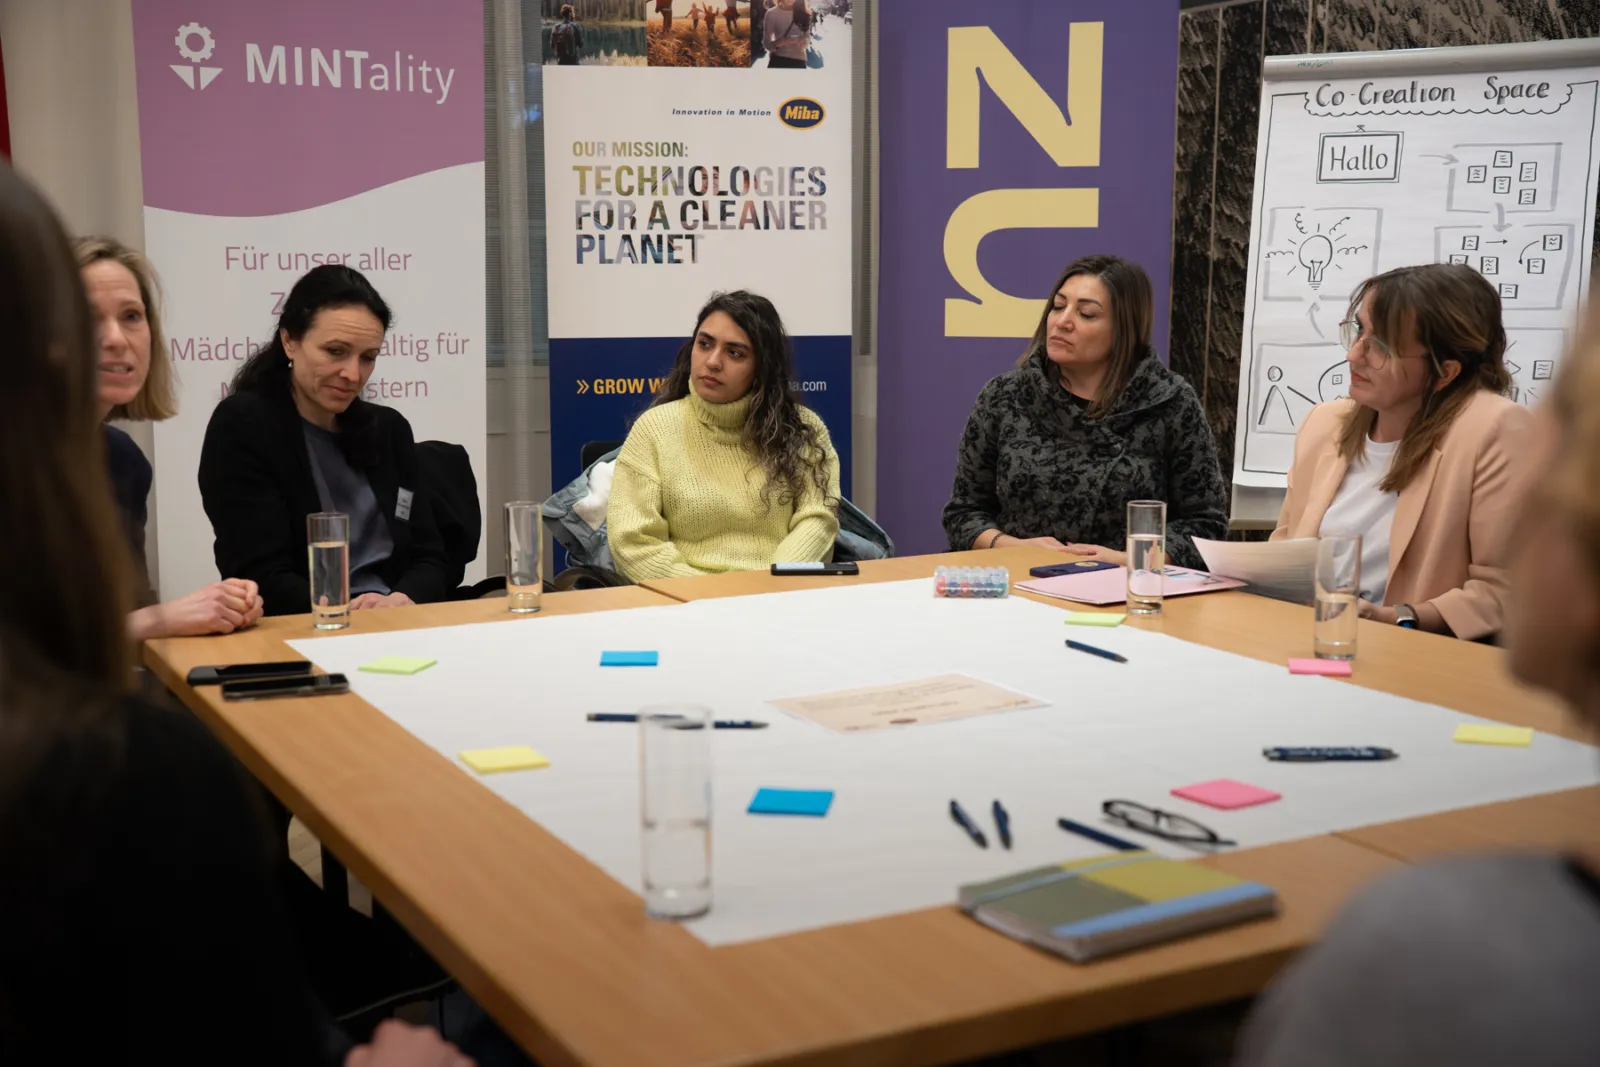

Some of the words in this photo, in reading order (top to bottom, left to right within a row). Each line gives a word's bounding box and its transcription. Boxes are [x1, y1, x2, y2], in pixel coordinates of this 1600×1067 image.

[245, 43, 455, 104] MINTality
[1484, 76, 1550, 105] Space
[672, 108, 722, 116] Innovation
[785, 105, 820, 120] Miba
[572, 142, 607, 157] OUR
[611, 142, 688, 157] MISSION:
[1330, 144, 1388, 172] Hallo
[572, 166, 827, 197] TECHNOLOGIES
[575, 200, 637, 231] FOR
[647, 200, 671, 230] A
[680, 200, 827, 231] CLEANER
[225, 246, 270, 271] Für
[358, 247, 413, 271] aller
[576, 234, 704, 265] PLANET
[170, 336, 262, 362] Mädch
[436, 332, 470, 355] für
[593, 379, 645, 395] GROW
